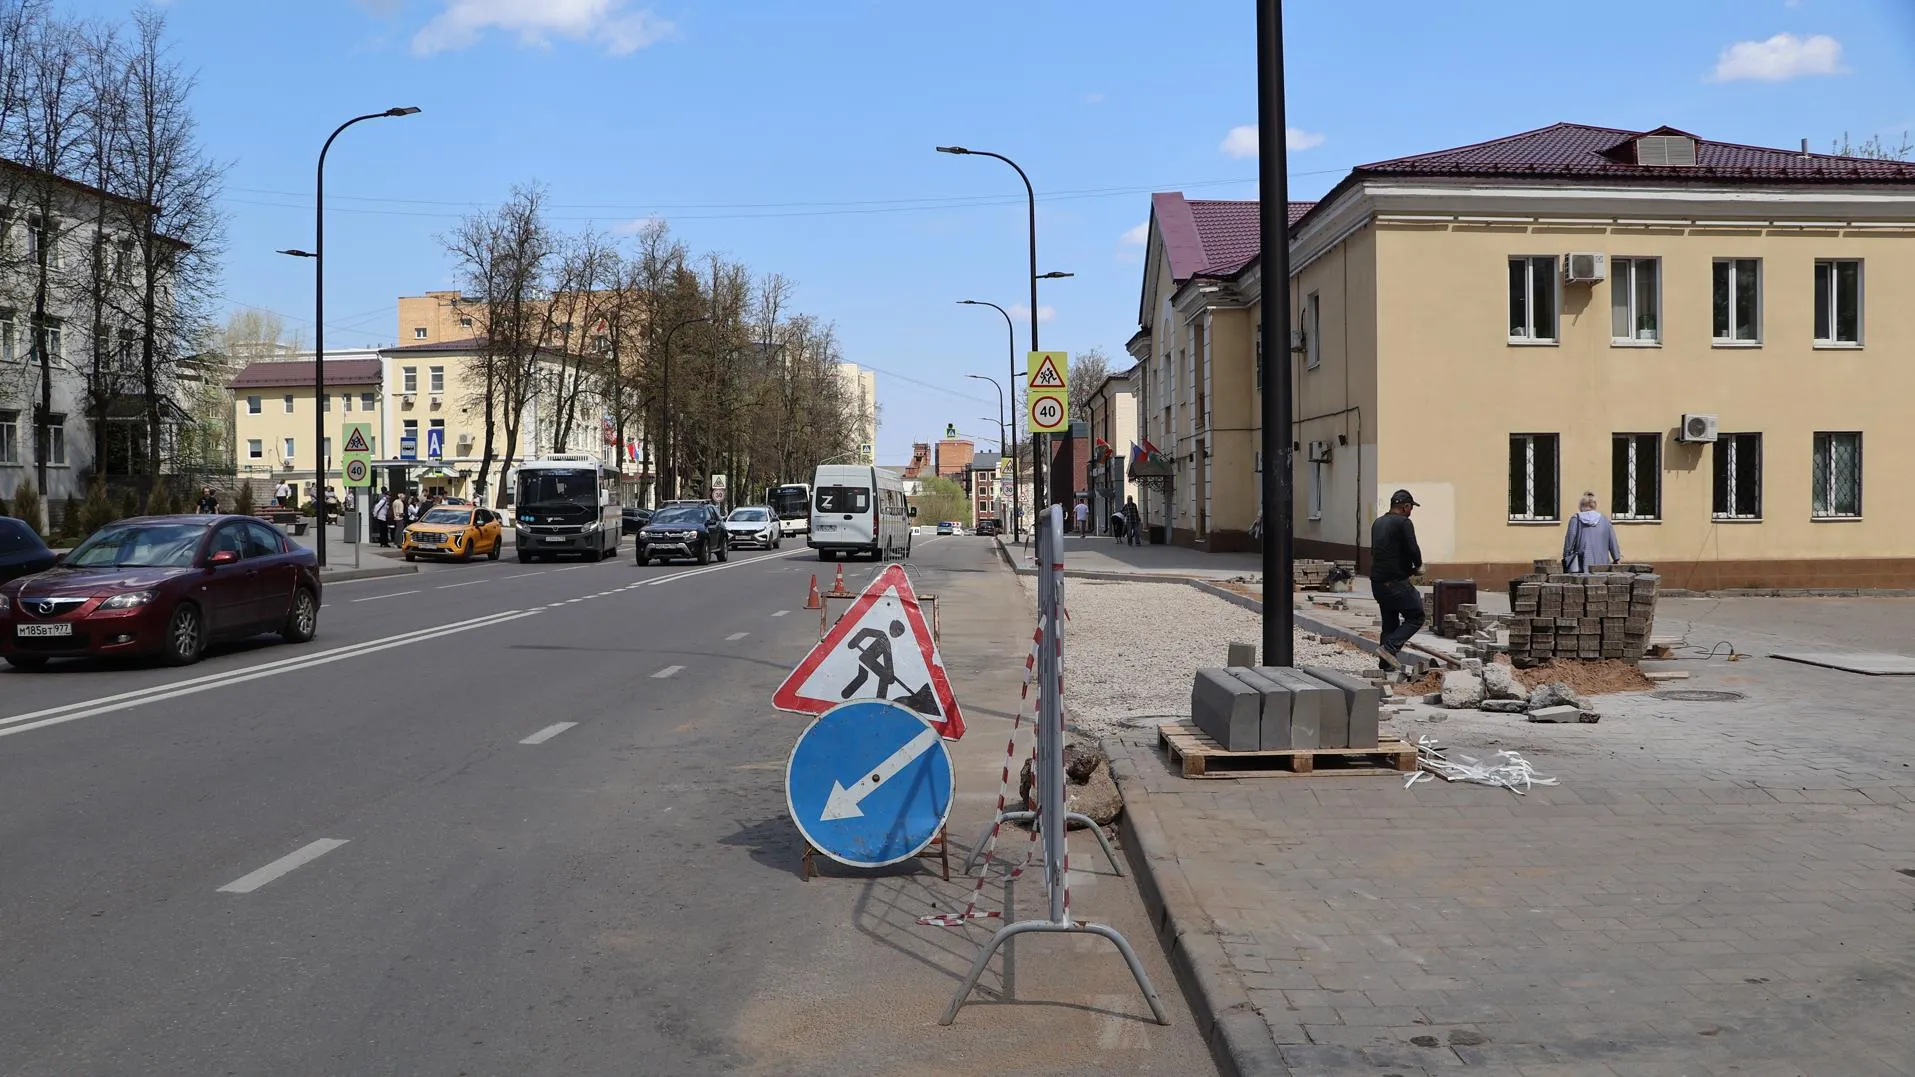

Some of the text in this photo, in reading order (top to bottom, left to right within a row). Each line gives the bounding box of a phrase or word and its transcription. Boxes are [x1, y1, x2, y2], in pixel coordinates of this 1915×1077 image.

[1040, 405, 1056, 418] 40
[351, 466, 362, 476] 40
[821, 495, 834, 507] Z
